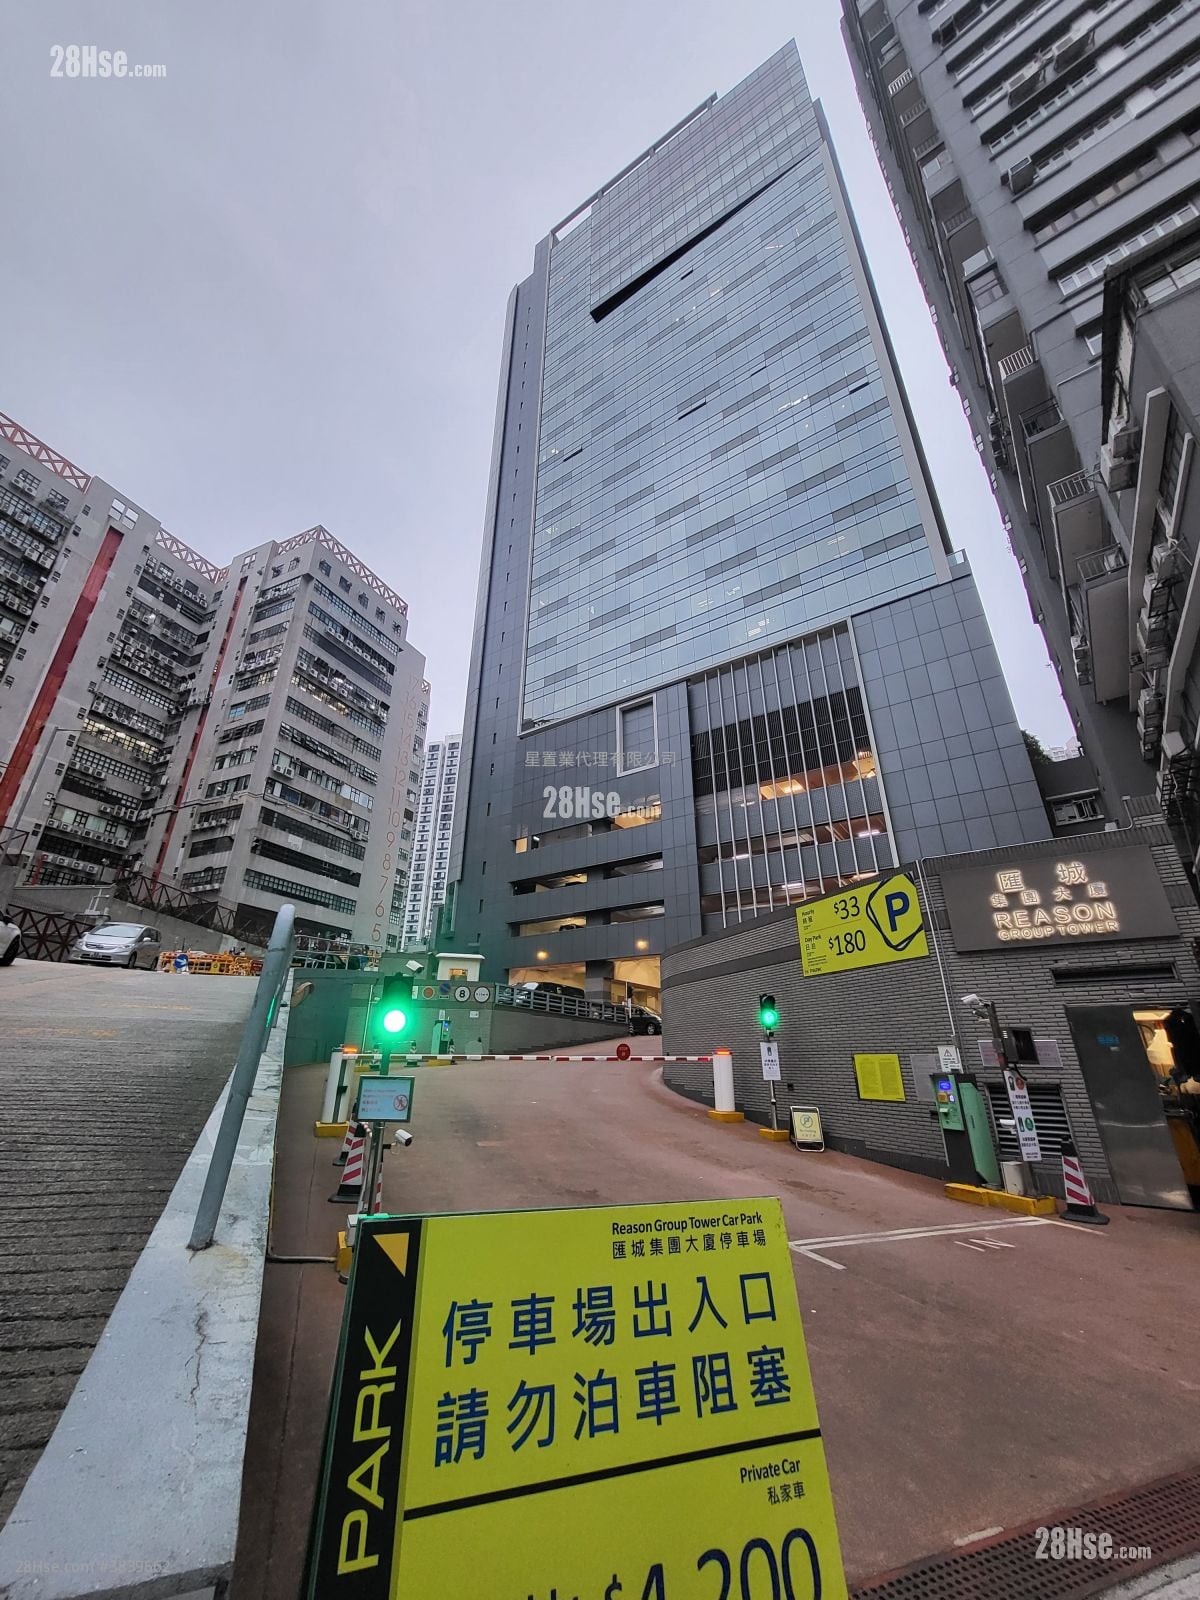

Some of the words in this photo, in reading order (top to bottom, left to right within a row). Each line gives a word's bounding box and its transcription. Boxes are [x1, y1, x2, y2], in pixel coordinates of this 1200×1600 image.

[388, 807, 400, 828] 10
[386, 832, 395, 847] 9
[383, 853, 391, 871] 8
[380, 875, 388, 893] 7
[997, 862, 1088, 892] 匯城
[376, 900, 384, 917] 6
[834, 896, 860, 919] $33
[885, 891, 910, 932] P
[994, 902, 1117, 928] REASON
[372, 923, 381, 941] 5
[998, 925, 1055, 941] GROUP
[1056, 921, 1120, 936] TOWER
[828, 930, 866, 956] $180
[459, 989, 466, 998] 8
[612, 1222, 652, 1235] Reason
[654, 1219, 687, 1232] Group
[689, 1216, 720, 1229] Tower
[722, 1214, 738, 1226] Car
[740, 1212, 762, 1224] Park
[613, 1229, 766, 1260] 匯城集團大廈停車場
[442, 1271, 776, 1368] 停車場出入口
[434, 1344, 791, 1467] 請勿泊車阻塞
[337, 1319, 401, 1576] PARK
[740, 1462, 780, 1483] Private
[781, 1459, 800, 1474] Car
[767, 1480, 805, 1505] 私家車
